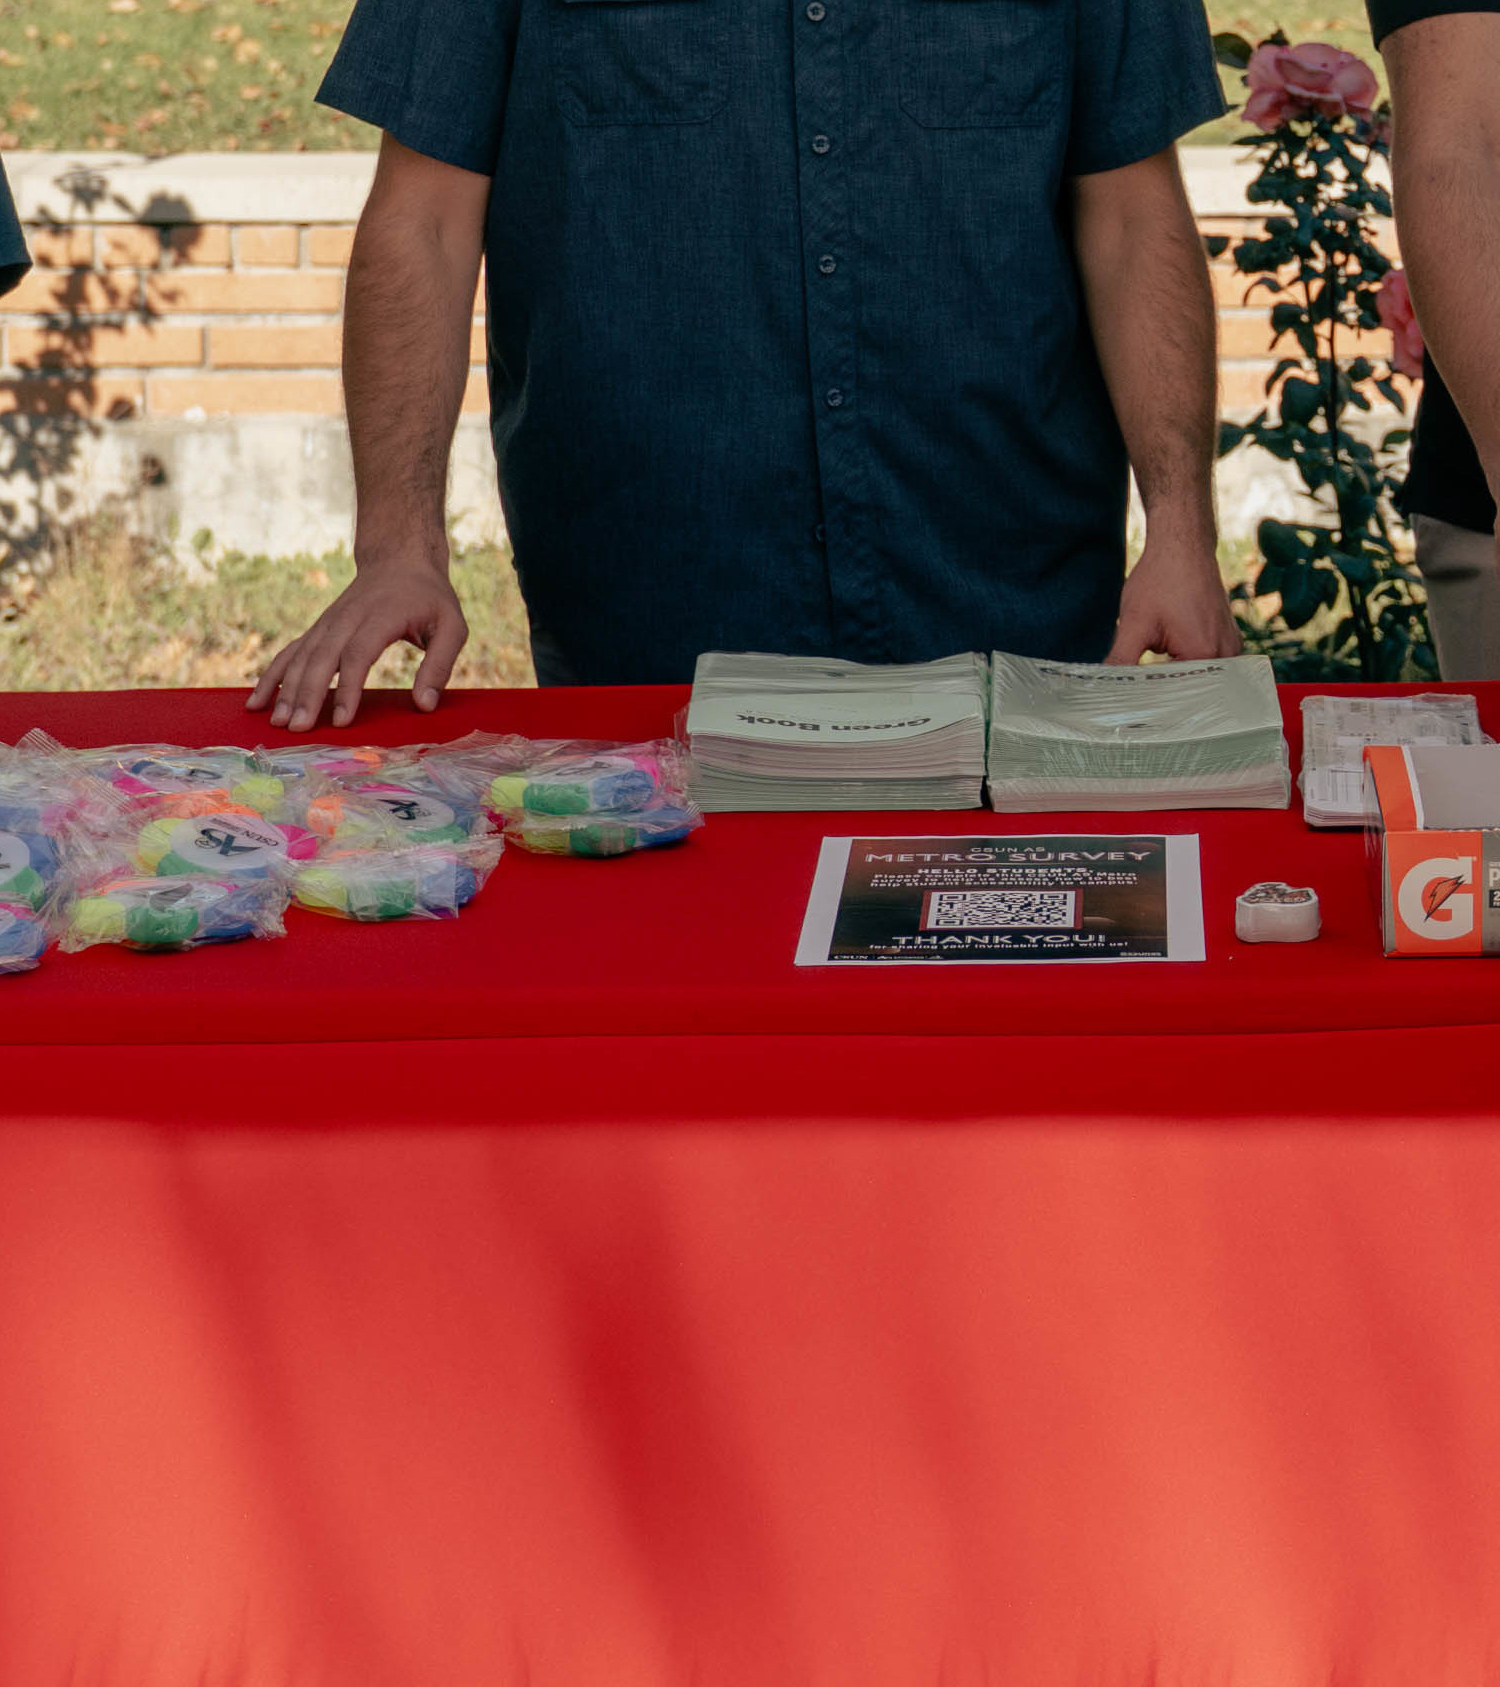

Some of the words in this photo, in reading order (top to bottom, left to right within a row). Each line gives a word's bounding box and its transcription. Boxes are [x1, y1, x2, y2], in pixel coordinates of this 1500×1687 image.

[1039, 667, 1135, 681] Green
[1145, 666, 1225, 680] Book
[736, 714, 821, 731] Book
[831, 717, 931, 731] Green
[241, 829, 279, 847] CSUN
[865, 853, 996, 863] METRO
[1009, 851, 1151, 862] SURVEY
[1398, 856, 1474, 940] G
[892, 935, 1012, 945] THANK
[1022, 934, 1105, 943] YOU!
